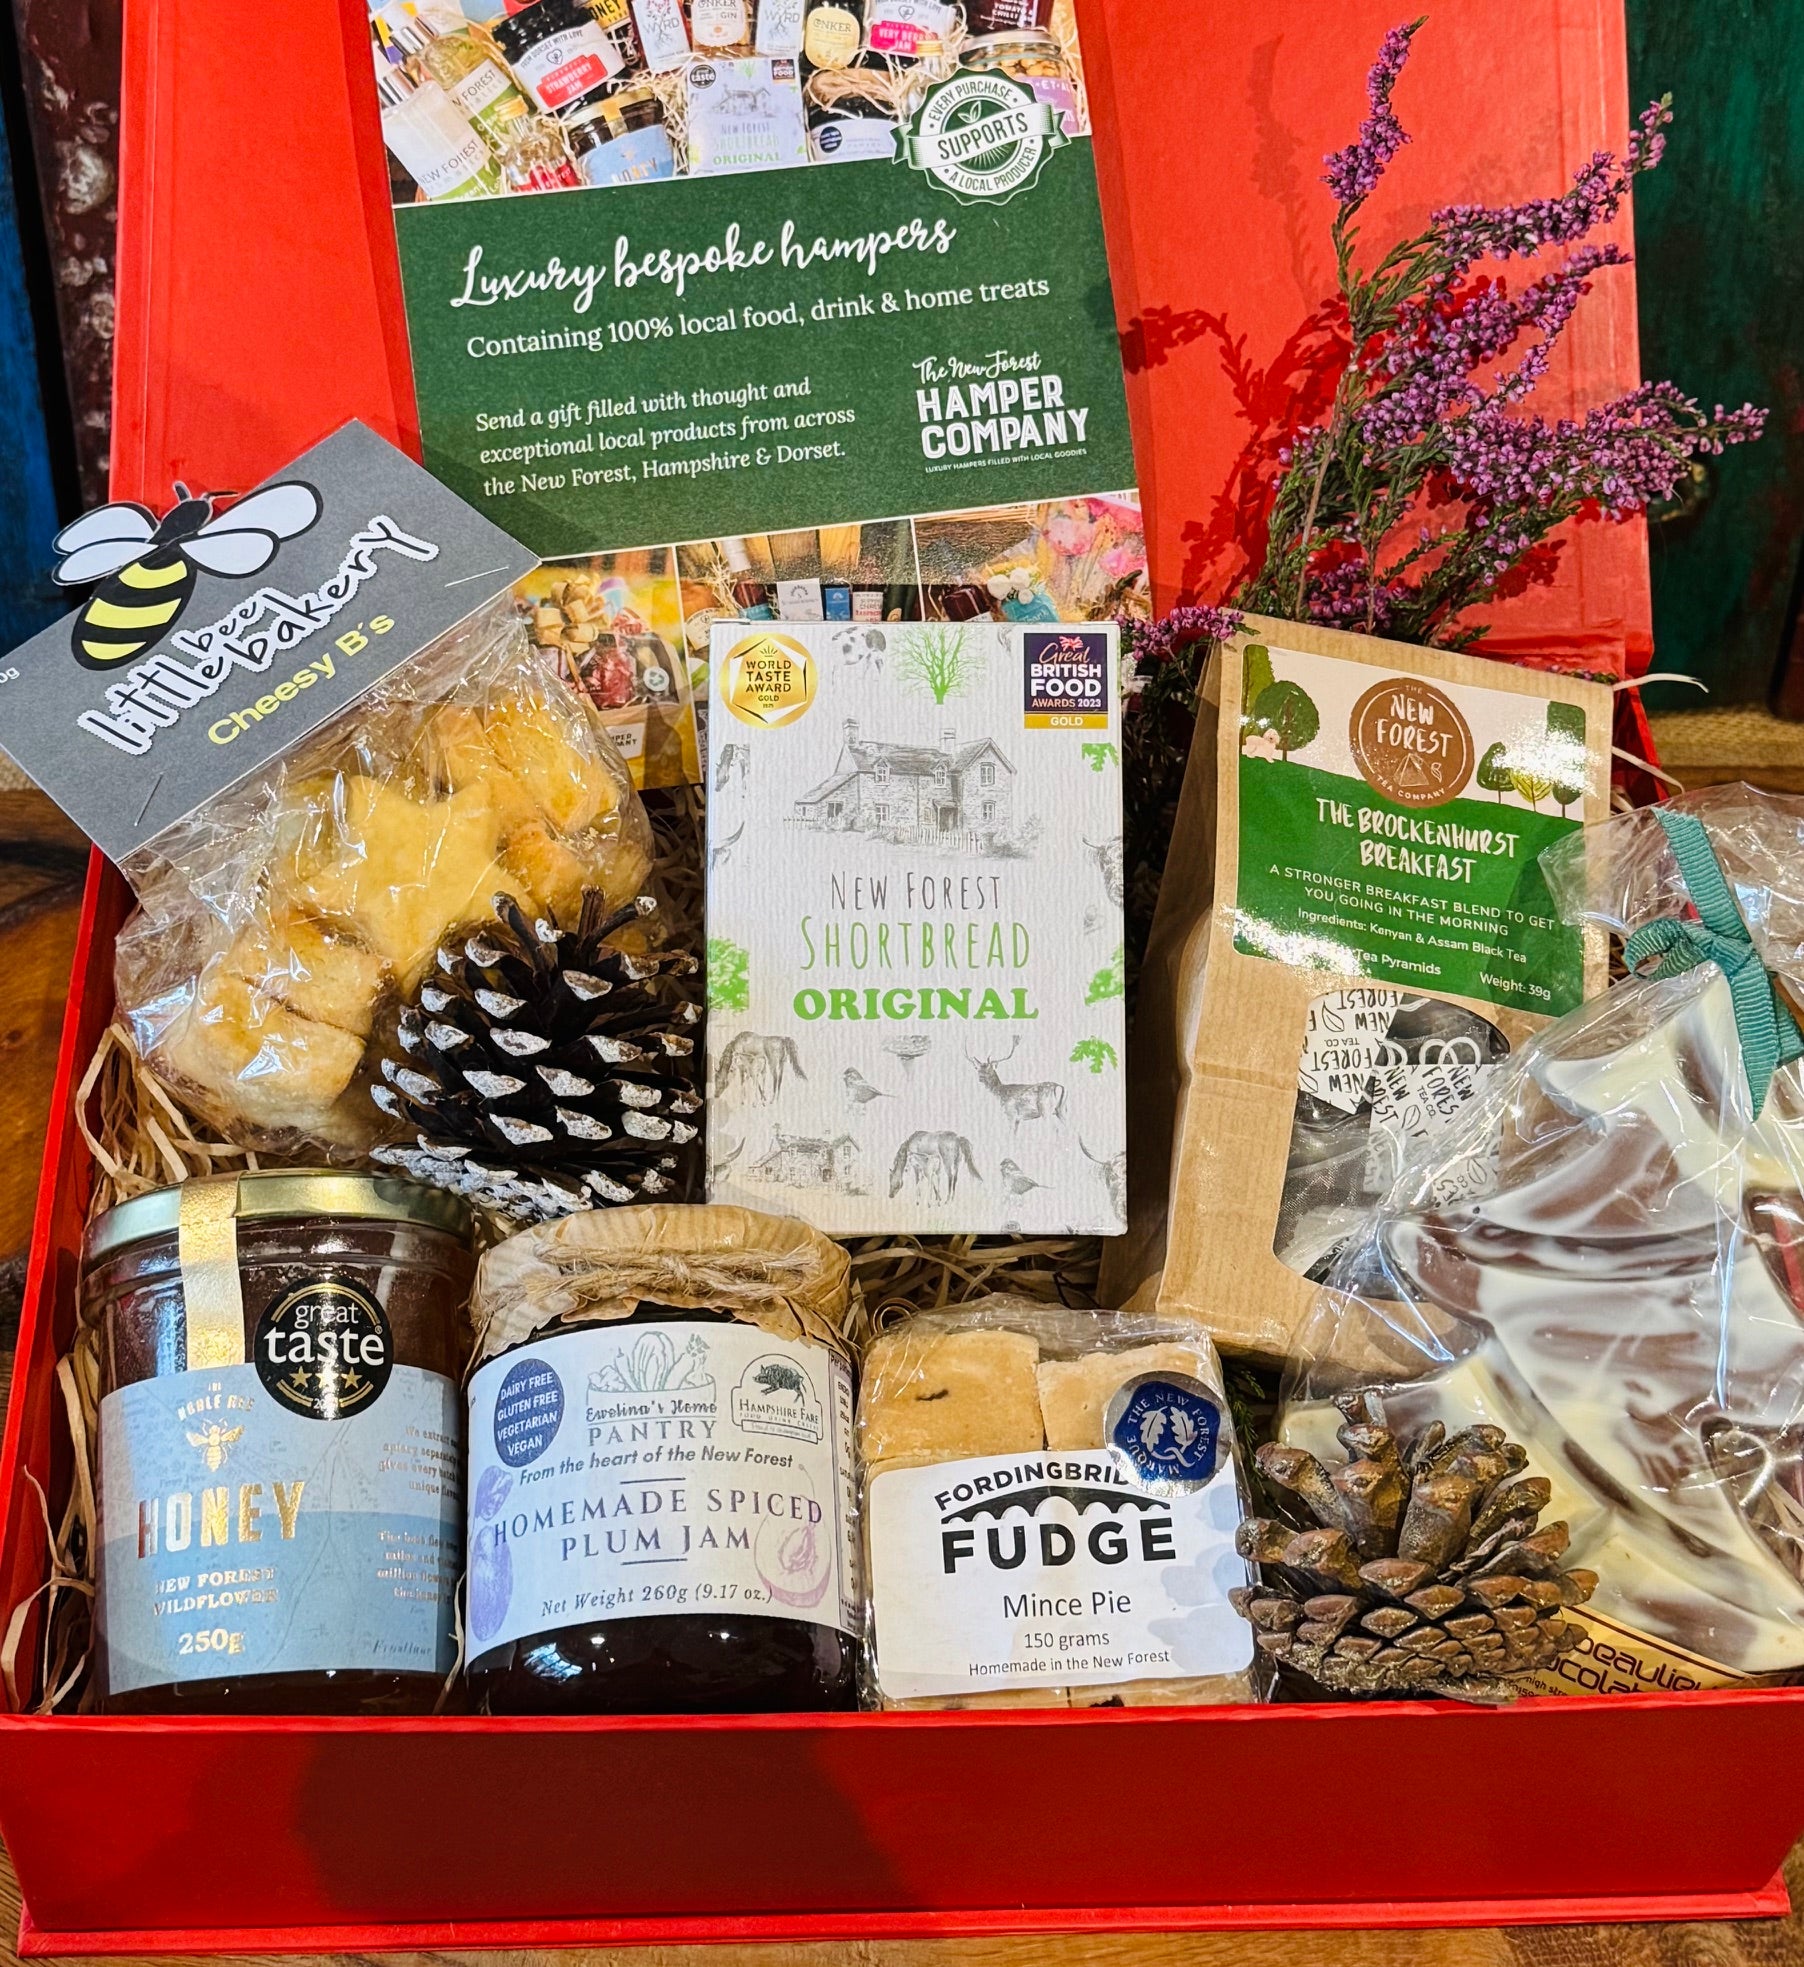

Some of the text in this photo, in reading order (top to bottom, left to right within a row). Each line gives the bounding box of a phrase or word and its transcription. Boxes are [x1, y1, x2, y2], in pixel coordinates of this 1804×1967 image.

[462, 69, 496, 101] FOREST
[928, 81, 1013, 122] EVERY PURCHASE
[937, 112, 1029, 160] SUPPORTS
[950, 147, 1037, 191] A LOCAL PRODUCER
[450, 218, 957, 314] Luxury bespoke hampers
[467, 278, 1050, 358] Containing 100% local food, drink & home treats
[912, 350, 1042, 384] The New Forest
[476, 377, 812, 432] Send a gift filled with thought and
[916, 374, 1065, 423] HAMPER
[480, 408, 856, 466] exceptional local products from across
[921, 407, 1089, 459] COMPANY
[484, 440, 846, 497] the New Forest, Hampshire & Dorset.
[925, 448, 1087, 473] LUXURY HAMPERS FILLED WITH LOCAL GOODIES
[185, 600, 257, 653] bee
[223, 520, 431, 665] bakery
[746, 660, 792, 670] WORLD
[1030, 663, 1102, 677] BRITISH
[1039, 642, 1090, 665] Great
[745, 683, 792, 693] AWARD
[746, 671, 791, 682] TASTE
[1030, 678, 1102, 697] FOOD
[1405, 684, 1422, 694] THE
[208, 651, 337, 747] Cheesy
[758, 694, 780, 702] GOLD
[1031, 698, 1102, 708] AWARDS 2023
[1390, 693, 1434, 726] NEW
[1050, 716, 1083, 726] GOLD
[1376, 718, 1453, 757] FOREST
[1376, 774, 1445, 801] TEA COMPANY
[1316, 797, 1520, 858] THE BROCKENHURST
[1359, 840, 1477, 883] BREAKFAST
[831, 870, 1001, 910] NEW FOREST
[1270, 864, 1555, 931] A STRONGER BREAKFAST BLEND TO GET
[1304, 886, 1509, 937] YOU GOING IN THE MORNING
[800, 915, 1029, 970] SHORTBREAD
[1298, 908, 1527, 964] Ingredients: Kenyan & Assam Black Tea
[1356, 948, 1442, 976] Tea Pyramids
[1479, 971, 1552, 1001] Weight: 39g
[793, 987, 1039, 1021] ORIGINAL
[1354, 1011, 1390, 1033] NEW
[1341, 1037, 1361, 1046] TEA
[1310, 1047, 1373, 1072] FOREST
[1328, 1073, 1364, 1095] NEW
[1384, 1066, 1410, 1101] NEW
[1417, 1085, 1428, 1104] TEA
[1447, 1065, 1475, 1101] NEW
[294, 1302, 359, 1329] great
[263, 1326, 385, 1366] taste
[501, 1371, 553, 1400] DAIRY FREE
[497, 1390, 558, 1422] GLUTEN FREE
[671, 1399, 717, 1415] Home
[739, 1398, 819, 1424] HAMPSHIRE FARE
[497, 1410, 558, 1441] VEGETARIAN
[588, 1420, 717, 1447] PANTRY
[1128, 1393, 1210, 1461] THE NEW FOREST
[507, 1434, 543, 1457] VEGAN
[1126, 1435, 1180, 1475] MARQUE
[519, 1446, 793, 1487] From the heart of the New Forest
[138, 1481, 305, 1559] HONEY
[494, 1489, 687, 1547] HOMEMADE
[707, 1488, 823, 1524] SPICED
[561, 1525, 751, 1561] PLUM JAM
[942, 1517, 1176, 1574] FUDGE
[155, 1576, 191, 1595] NEW
[542, 1583, 774, 1617] Net Weight 260g (9.17 oz.)
[1003, 1591, 1132, 1618] Mince Pie
[178, 1628, 245, 1656] 250g
[1024, 1632, 1110, 1651] 150 grams
[969, 1650, 1170, 1677] Homemade in the New Forest
